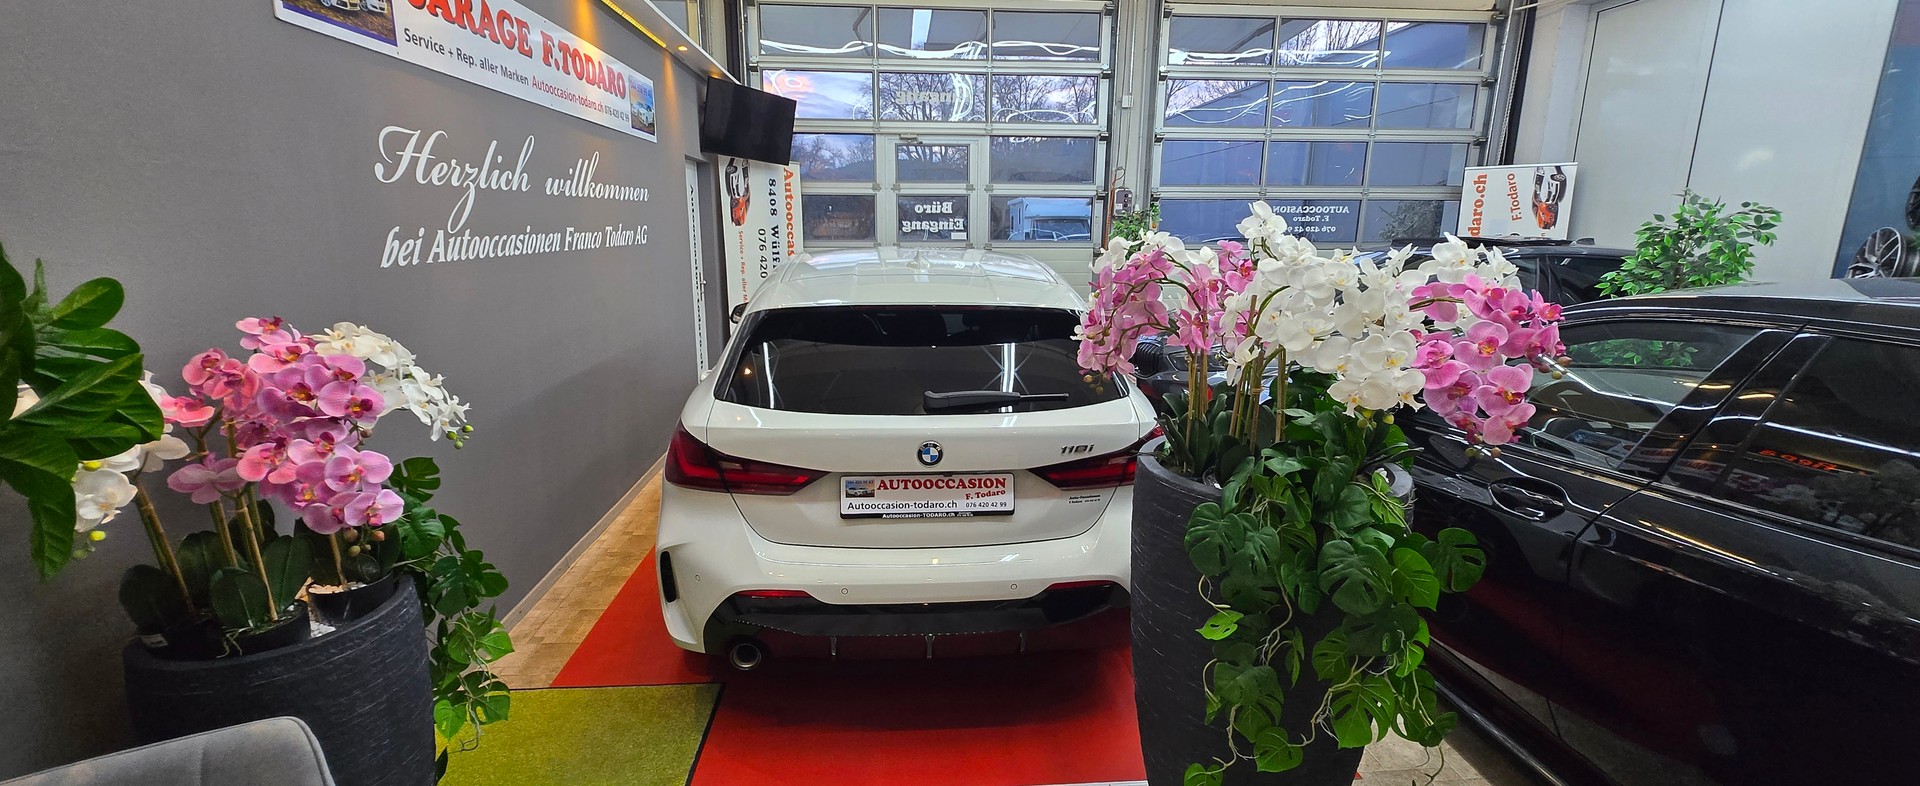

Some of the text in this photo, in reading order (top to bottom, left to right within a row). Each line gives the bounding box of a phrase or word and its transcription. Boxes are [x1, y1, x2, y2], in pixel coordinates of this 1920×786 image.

[403, 27, 446, 56] Service
[456, 47, 478, 69] Rep.
[479, 57, 499, 75] aller
[500, 64, 530, 86] Marken
[531, 75, 604, 114] Autooccasion-todaro.ch
[540, 30, 627, 100] F.TODARO
[374, 125, 650, 235] Herzlich willkommen
[767, 178, 777, 217] 8408
[1507, 172, 1523, 222] F.Todaro
[380, 223, 649, 268] bei Autooccasionen Franco Todaro AG
[757, 228, 767, 280] 076 420
[847, 500, 958, 511] Autooccasion-todaro.ch
[876, 478, 1006, 490] AUTOOCCASION
[974, 490, 1006, 500] Todaro
